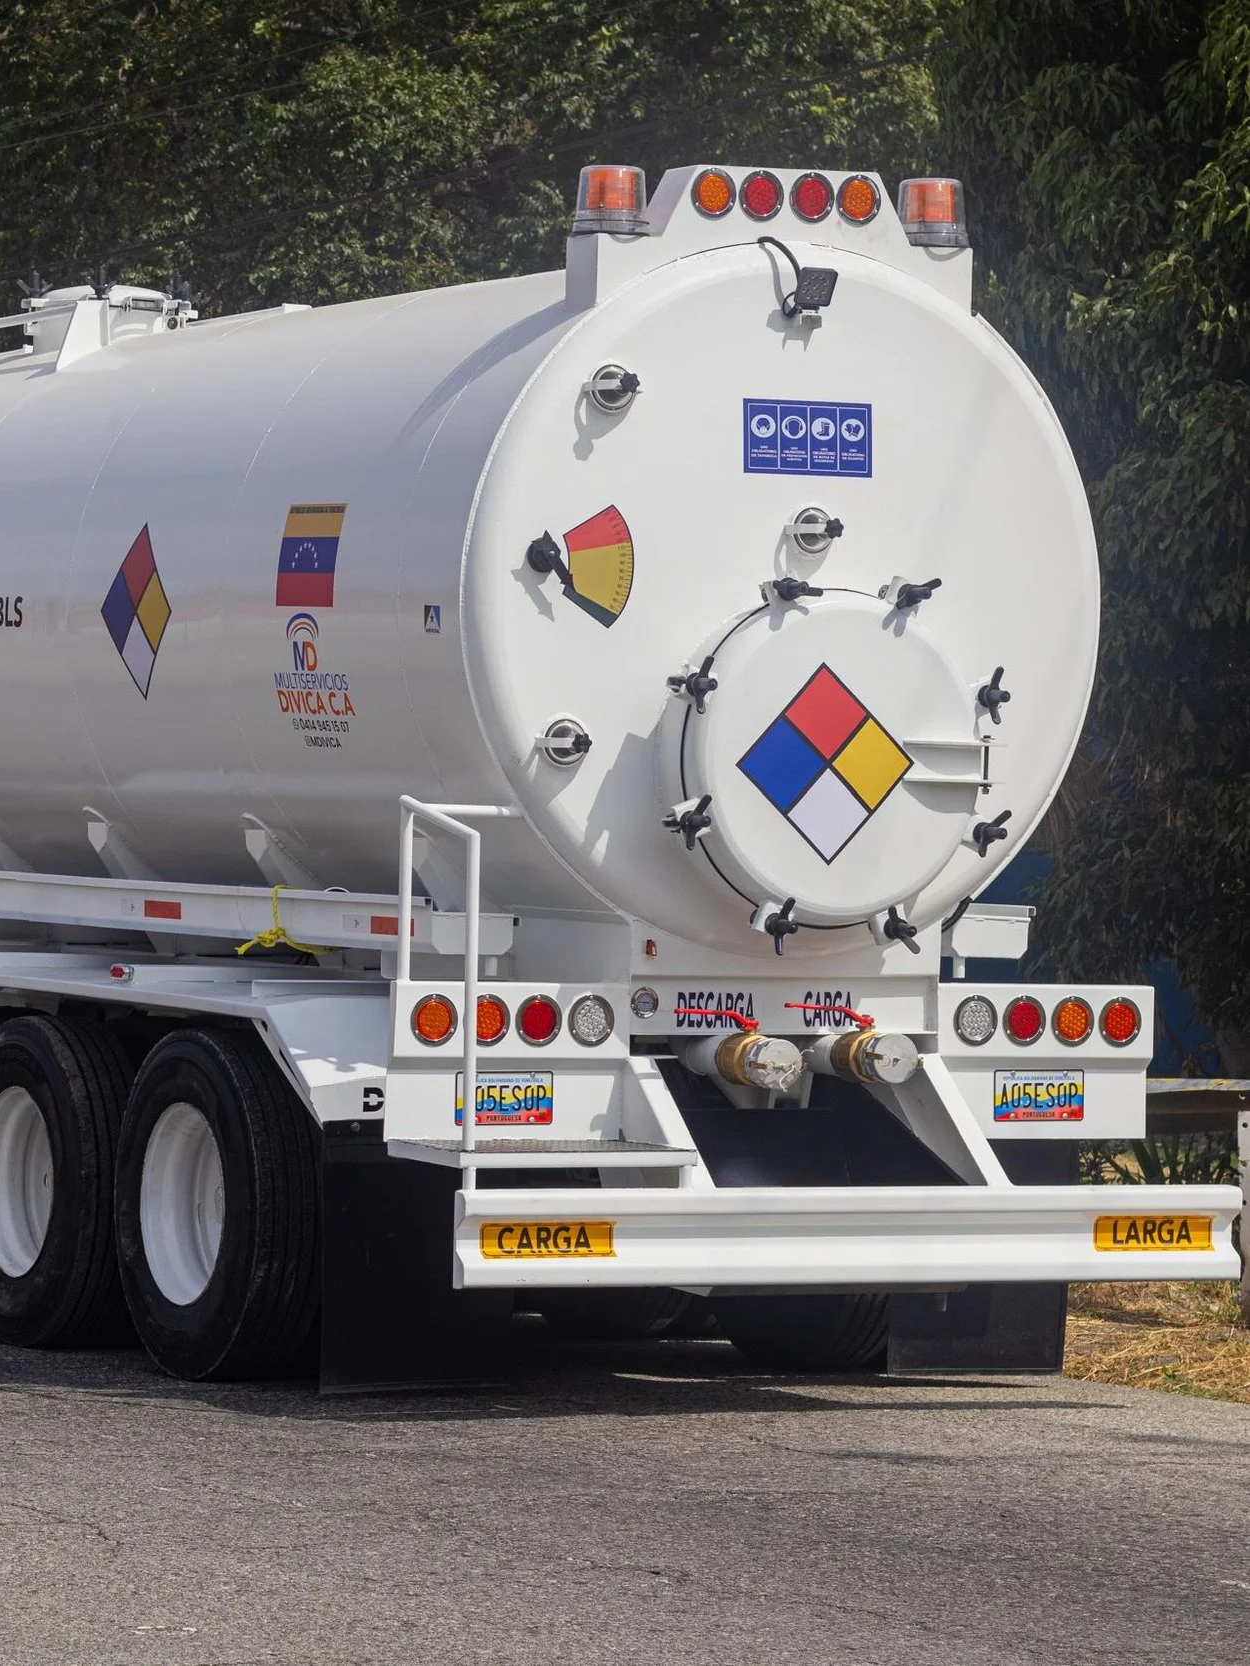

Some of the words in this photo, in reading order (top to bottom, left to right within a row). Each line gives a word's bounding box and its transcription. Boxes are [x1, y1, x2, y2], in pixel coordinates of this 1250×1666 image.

[278, 690, 328, 715] DIVICA
[329, 692, 356, 716] C.A
[676, 992, 754, 1029] DESCARGA
[803, 991, 853, 1027] CARGA
[498, 1226, 594, 1254] CARGA
[1112, 1219, 1192, 1244] LARGA
